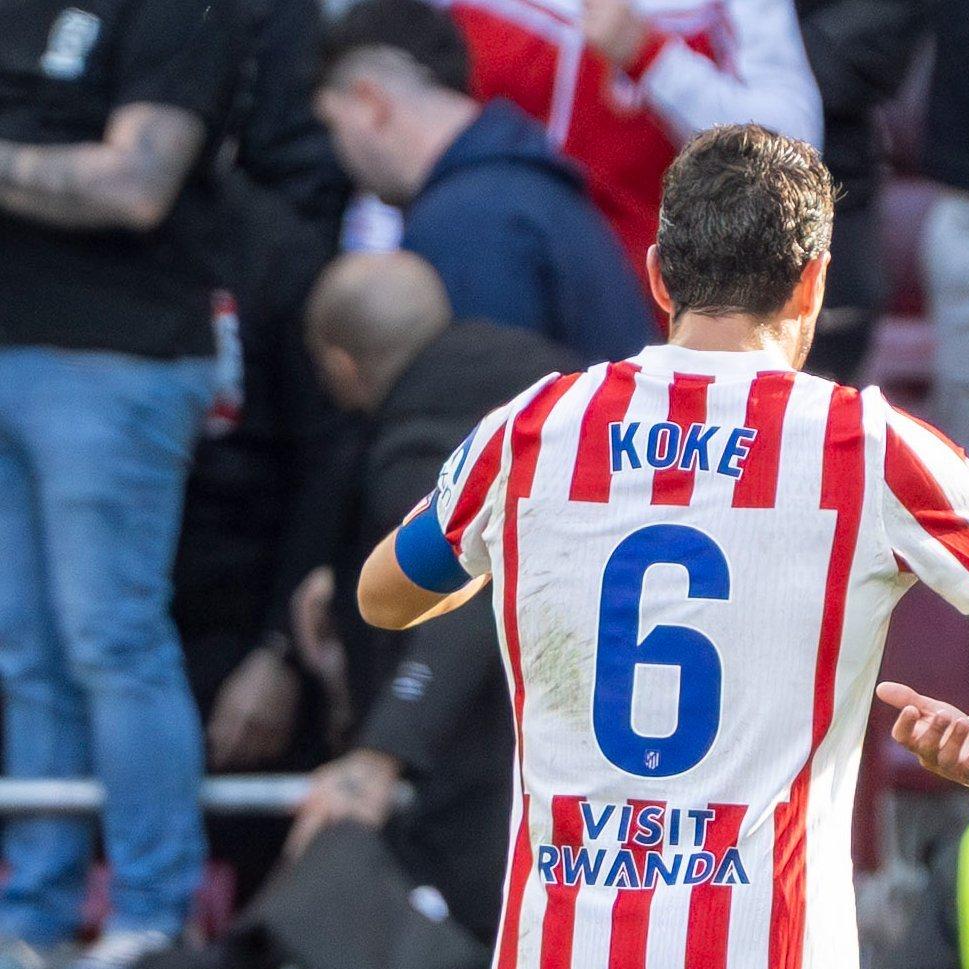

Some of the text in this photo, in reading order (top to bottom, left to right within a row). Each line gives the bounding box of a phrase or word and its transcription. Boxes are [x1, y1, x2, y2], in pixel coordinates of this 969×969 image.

[609, 421, 757, 479] KOKE
[592, 523, 731, 779] 6
[580, 801, 715, 849] VISIT
[538, 845, 751, 889] RWANDA
